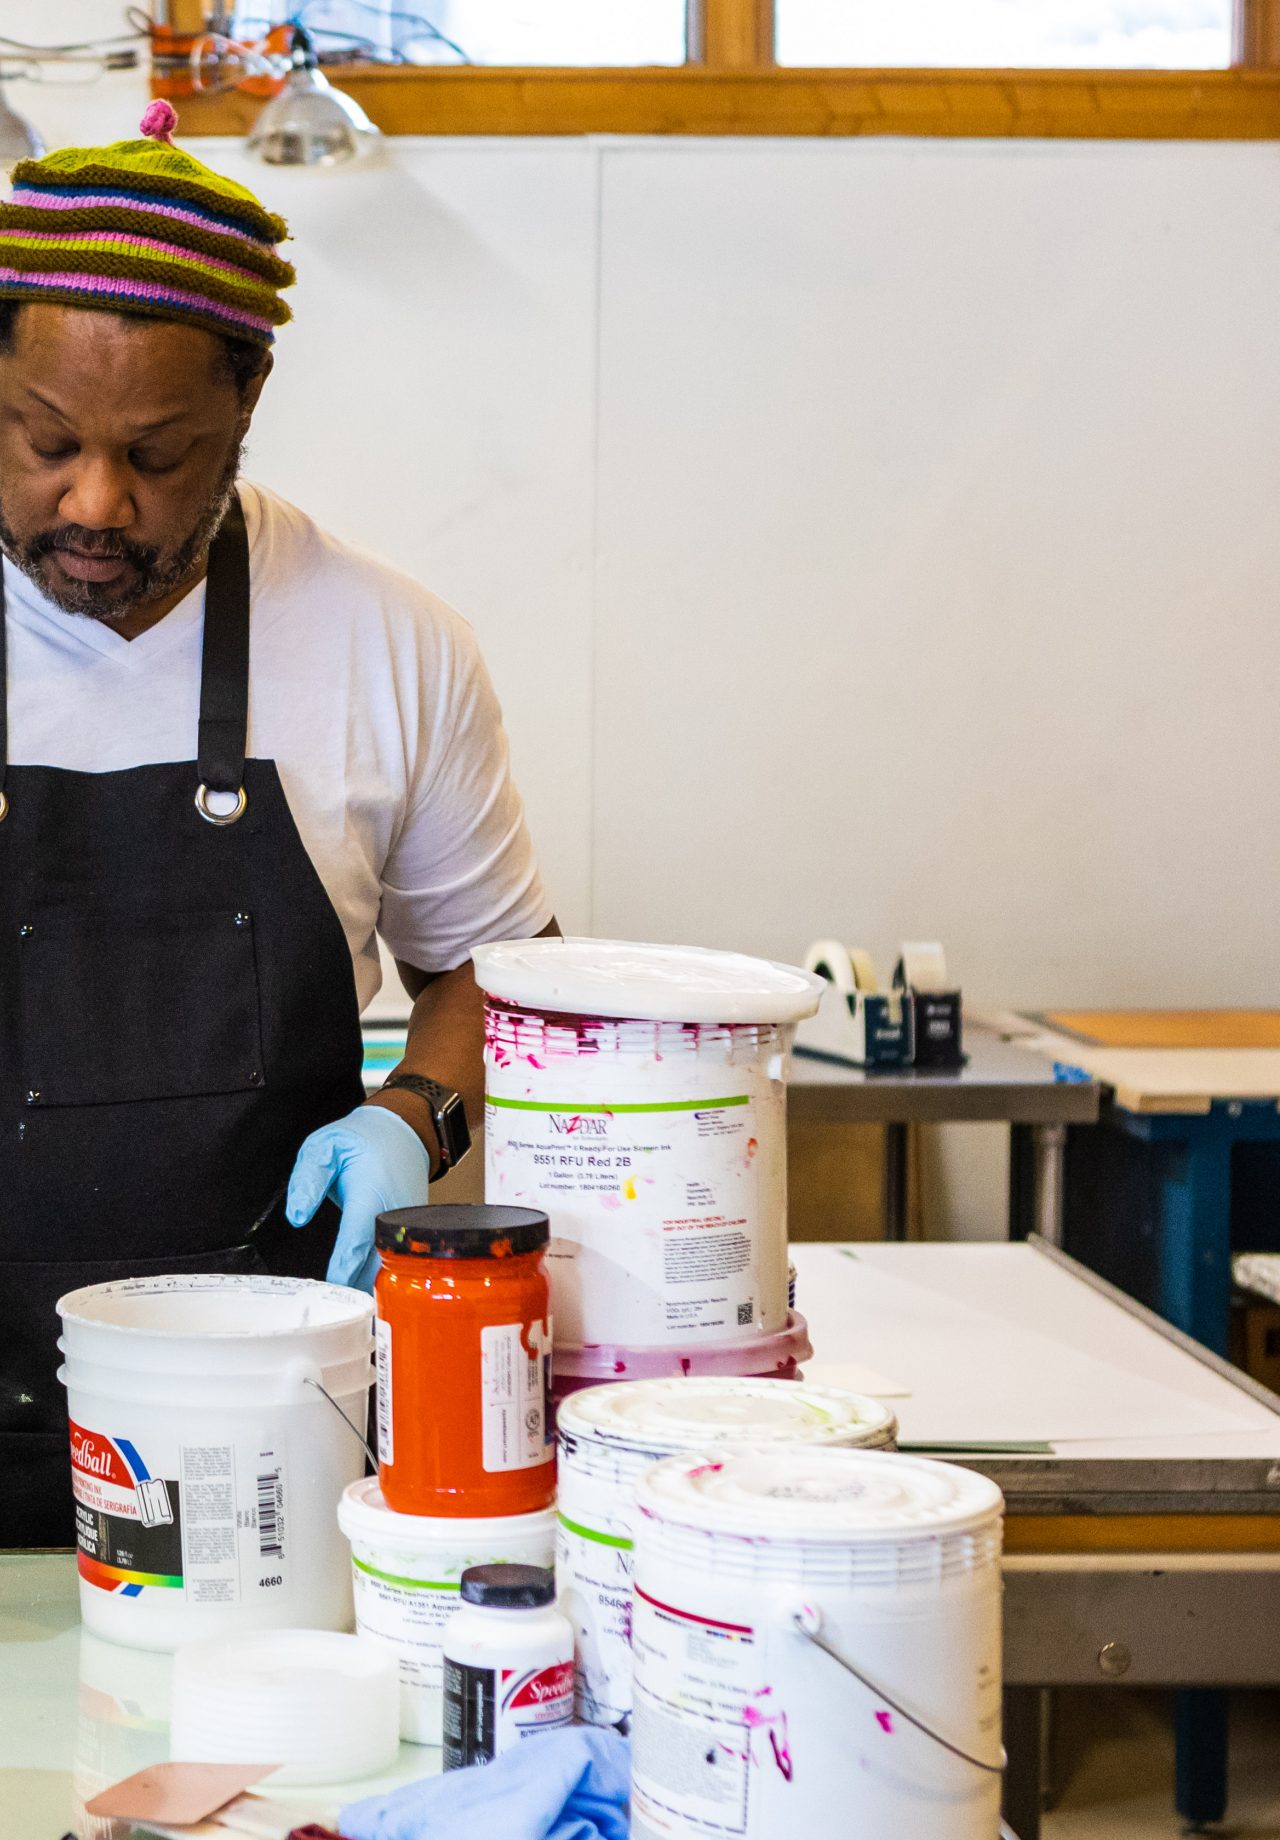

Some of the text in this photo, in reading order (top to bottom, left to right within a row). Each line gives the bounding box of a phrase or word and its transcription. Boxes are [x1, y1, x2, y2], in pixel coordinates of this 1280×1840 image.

[549, 1114, 607, 1135] NAZDAR
[533, 1153, 632, 1167] 9551 RFU Red 2B
[70, 1431, 112, 1477] eedball
[259, 1576, 283, 1588] 4660
